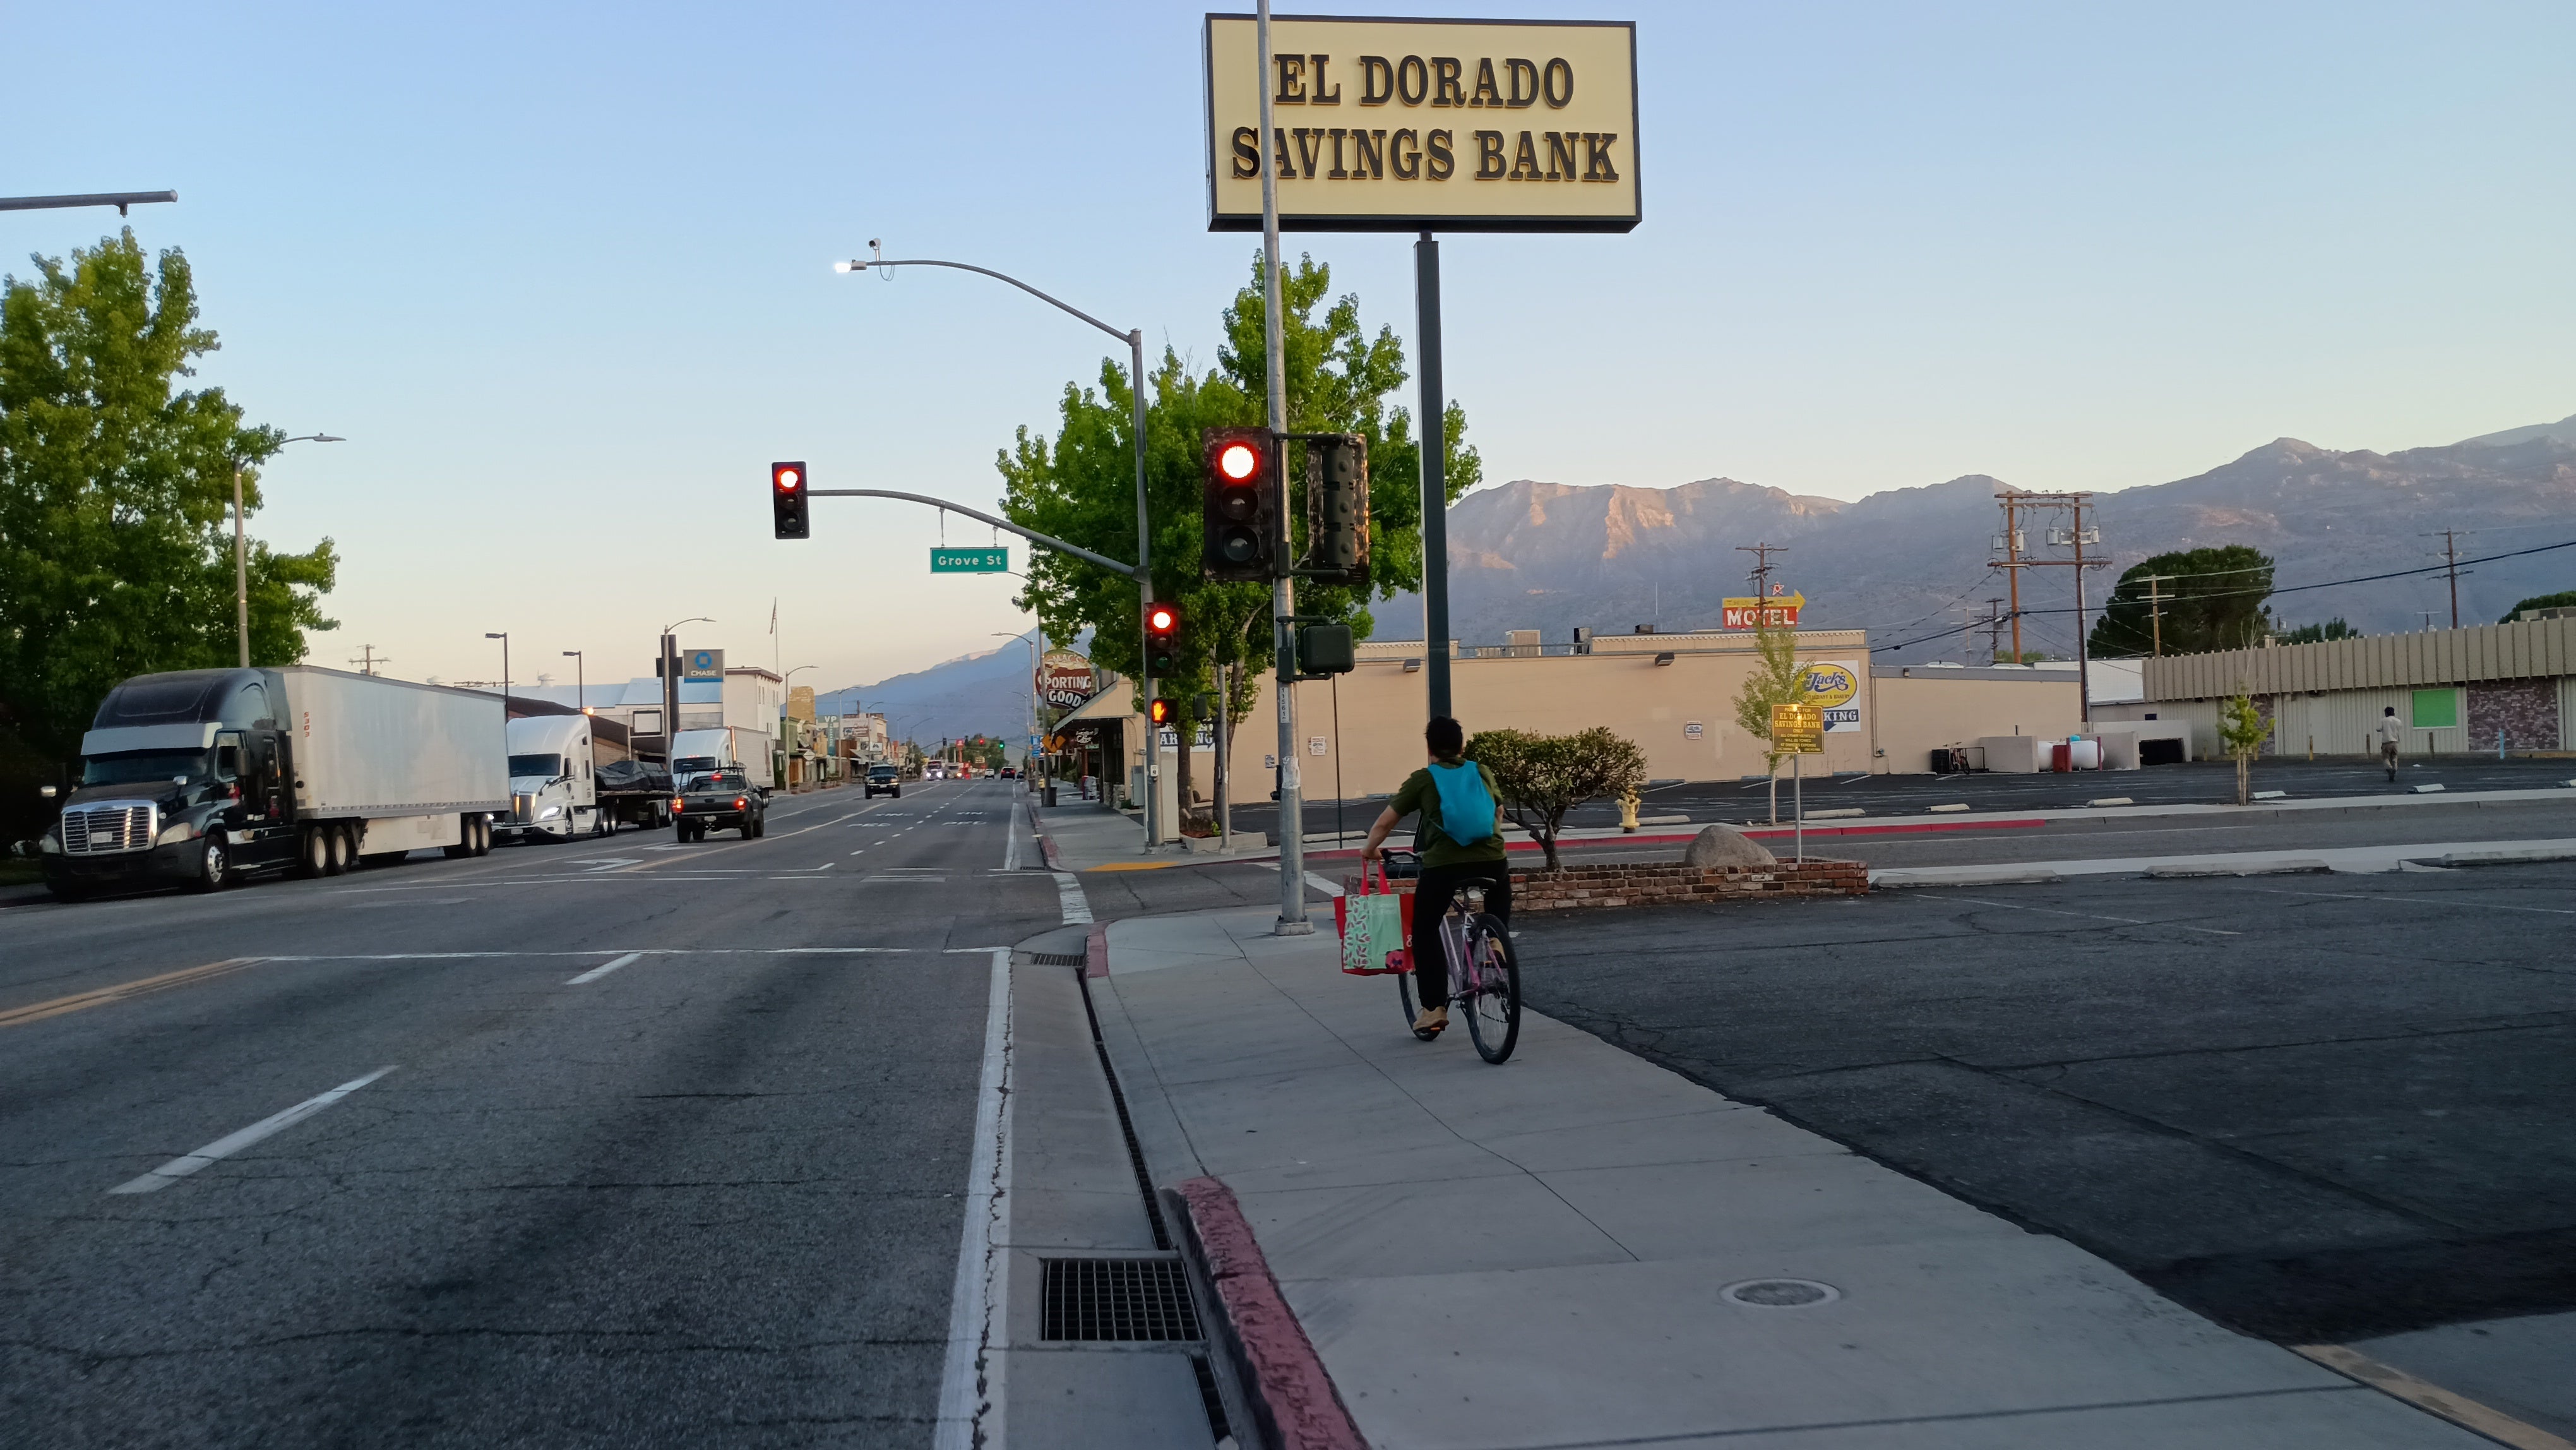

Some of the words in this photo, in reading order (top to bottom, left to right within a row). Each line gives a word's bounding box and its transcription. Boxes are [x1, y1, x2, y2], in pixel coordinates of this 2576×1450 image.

[1273, 54, 1342, 105] EL
[1359, 54, 1575, 108] DORADO
[1231, 126, 1456, 181] SAVINGS
[1474, 129, 1620, 183] BANK
[938, 556, 979, 566] Grove
[986, 555, 1001, 565] St
[1727, 609, 1795, 626] MOTEL
[1802, 671, 1849, 693] Jack's
[1823, 710, 1857, 722] KING
